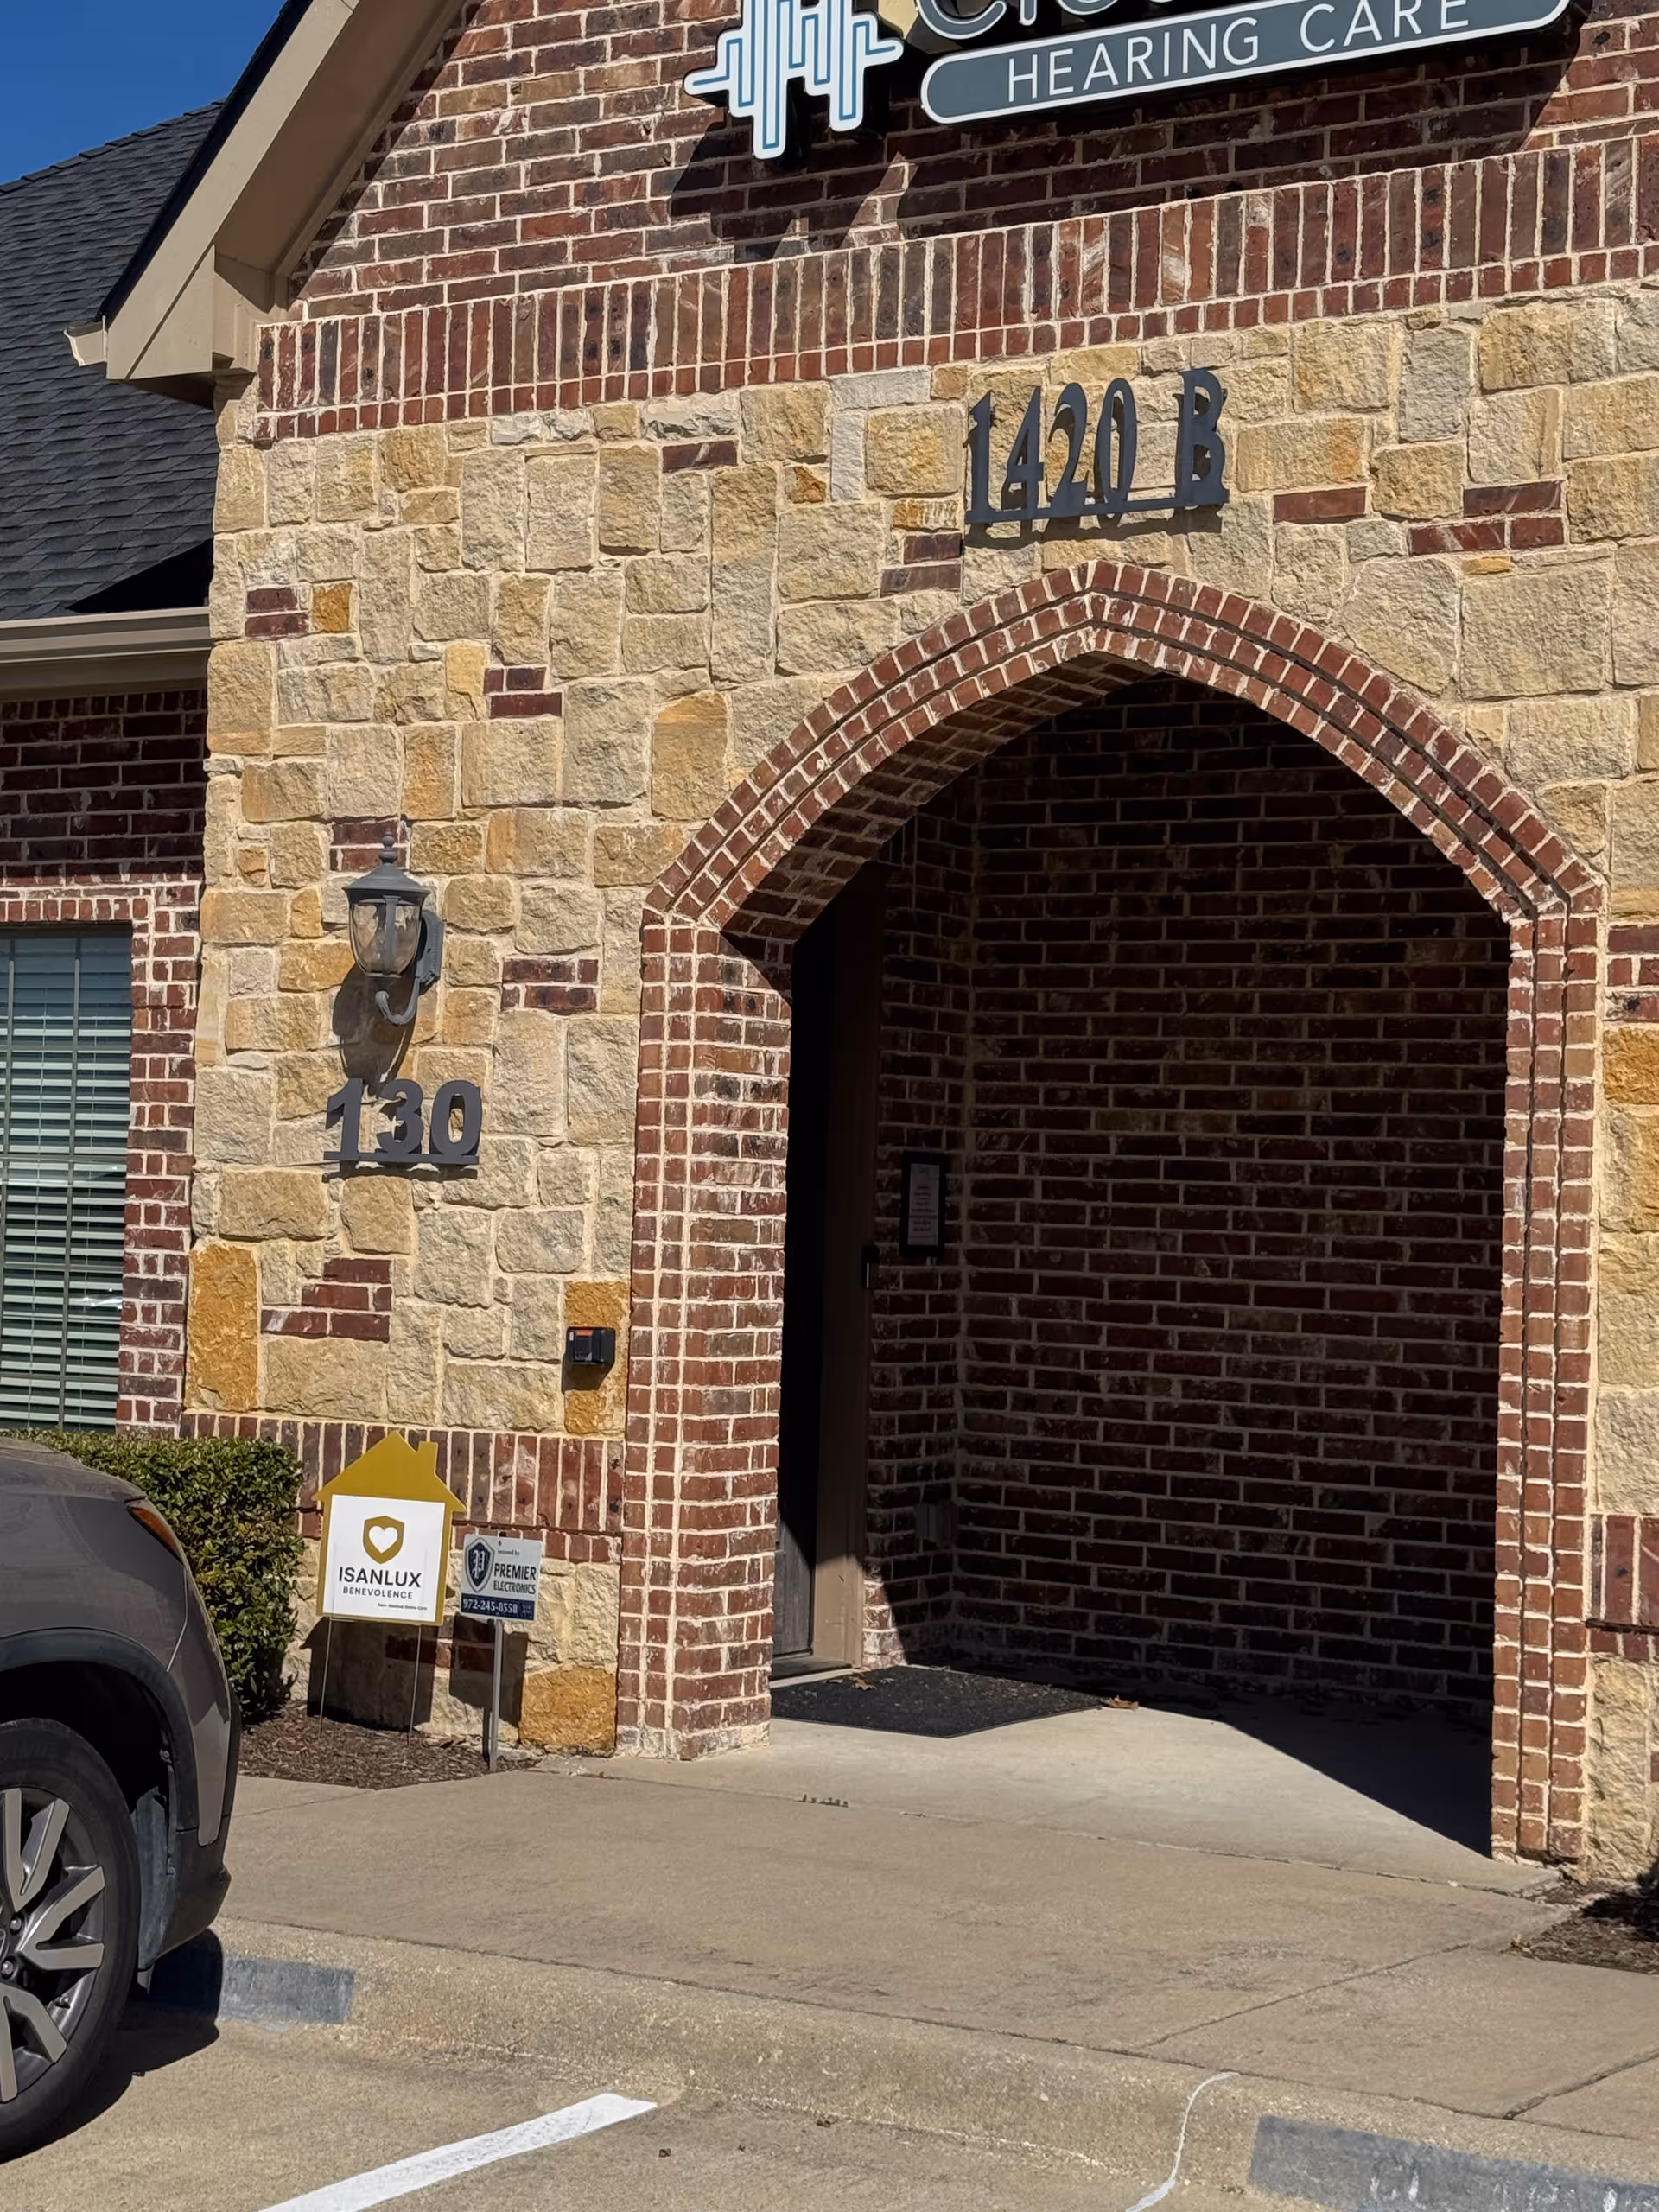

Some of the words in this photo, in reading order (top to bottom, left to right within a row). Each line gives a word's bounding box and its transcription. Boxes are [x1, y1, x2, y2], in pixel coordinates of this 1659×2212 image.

[1008, 17, 1259, 102] HEARING
[1300, 0, 1469, 53] CARE
[965, 378, 1138, 524] 1420
[1176, 368, 1230, 510] B
[323, 1077, 483, 1166] 130
[339, 1567, 422, 1588] ISANLUX
[494, 1562, 537, 1581] PREMIER
[343, 1586, 414, 1599] BENEVOLENCE
[493, 1580, 536, 1595] ELECTRONICS
